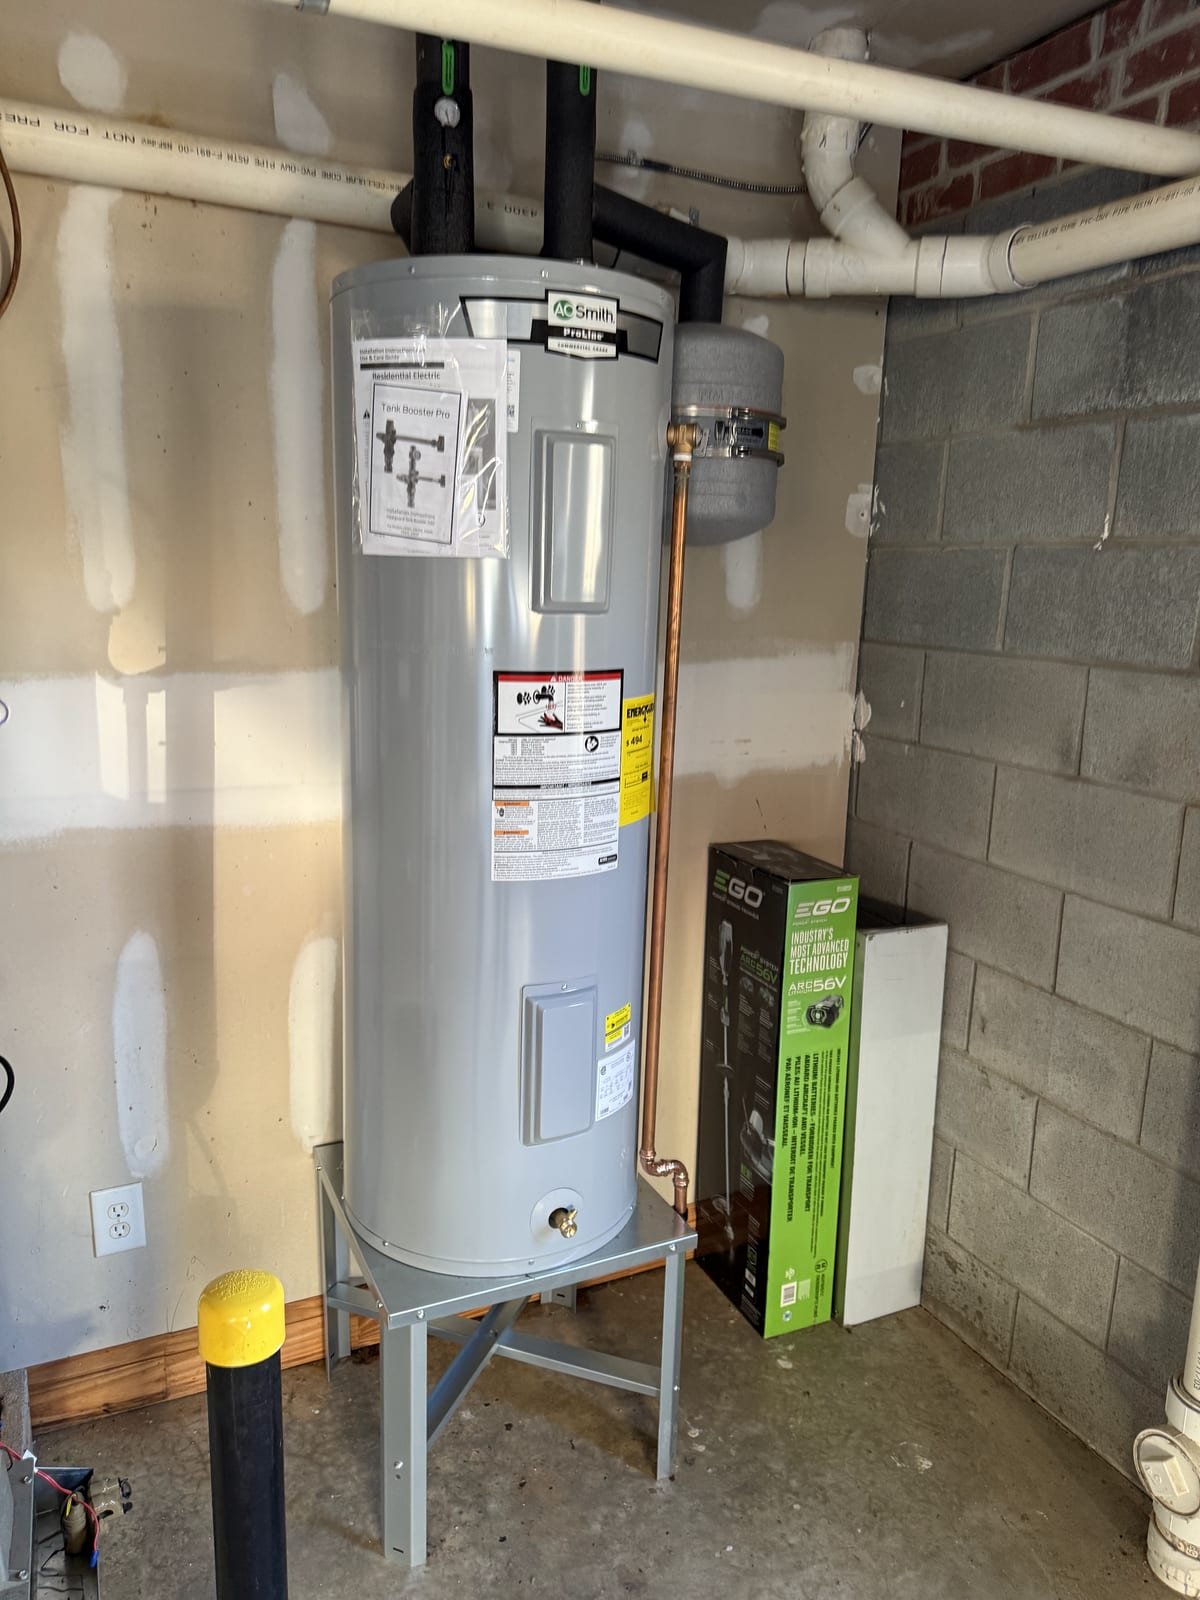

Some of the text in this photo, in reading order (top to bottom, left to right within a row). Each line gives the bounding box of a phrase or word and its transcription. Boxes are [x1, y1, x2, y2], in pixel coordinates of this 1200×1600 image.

[54, 121, 89, 136] FOR
[103, 128, 136, 144] NOT
[576, 304, 614, 323] Smith
[563, 327, 603, 341] ProLine
[372, 371, 440, 381] Residential Electric
[381, 403, 450, 419] Tank Booster Pro
[713, 869, 763, 909] EGO
[794, 897, 851, 919] EGO
[791, 927, 834, 945] INDUSTRY'S
[790, 938, 850, 959] MOST ADVANCED
[789, 951, 849, 975] TECHNOLOGY
[755, 964, 778, 985] 56V
[789, 974, 848, 992] ARC 56V
[803, 1054, 811, 1083] ABOARD
[794, 1076, 800, 1086] AU
[783, 1104, 790, 1113] ET
[792, 1087, 800, 1129] LITHIUM-ION
[810, 1081, 818, 1117] BATTERIES
[786, 1176, 795, 1222] TRANSPORTER
[804, 1176, 812, 1212] TRANSPORT
